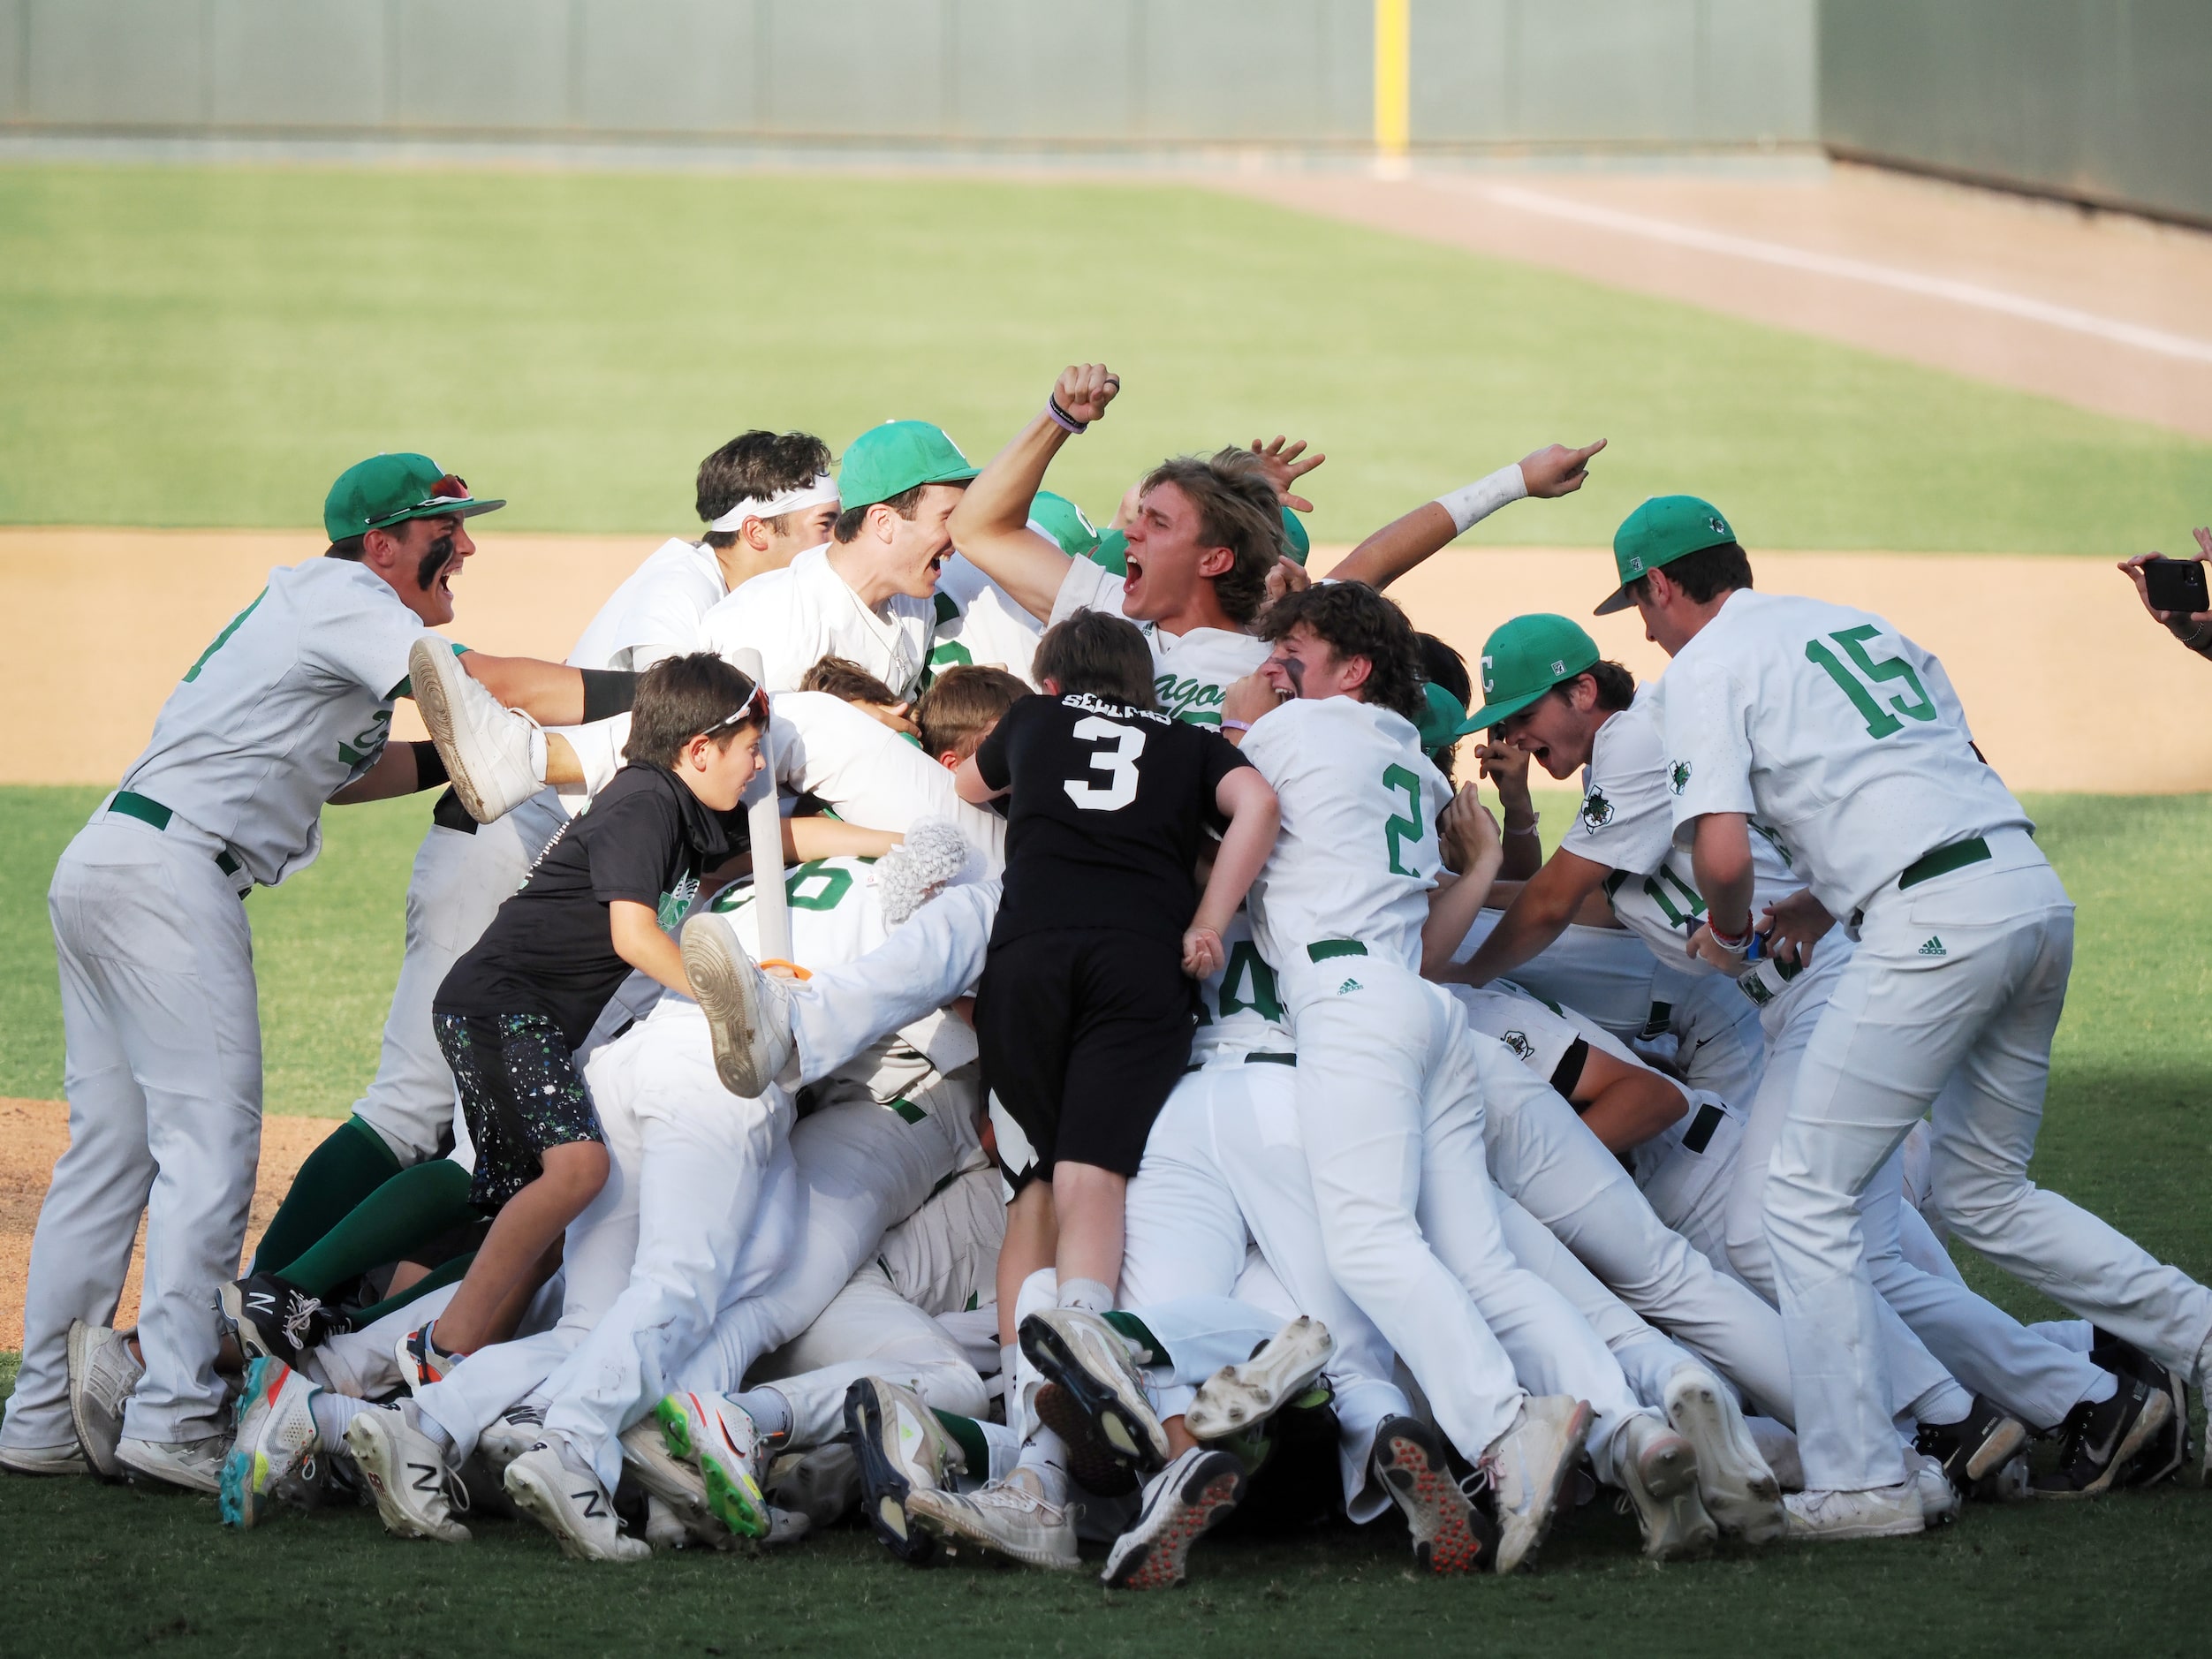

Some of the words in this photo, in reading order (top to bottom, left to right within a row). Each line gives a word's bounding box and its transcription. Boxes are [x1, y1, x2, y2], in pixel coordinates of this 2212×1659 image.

[1481, 655, 1494, 693] C
[1805, 624, 1937, 740] 15
[1063, 716, 1147, 811] 3
[1382, 762, 1424, 879] 2
[1643, 862, 1708, 929] 11
[1918, 946, 1947, 956] adidas
[1337, 984, 1364, 996] adidas
[246, 1292, 276, 1315] N
[406, 1462, 441, 1495] N
[571, 1490, 609, 1519] N
